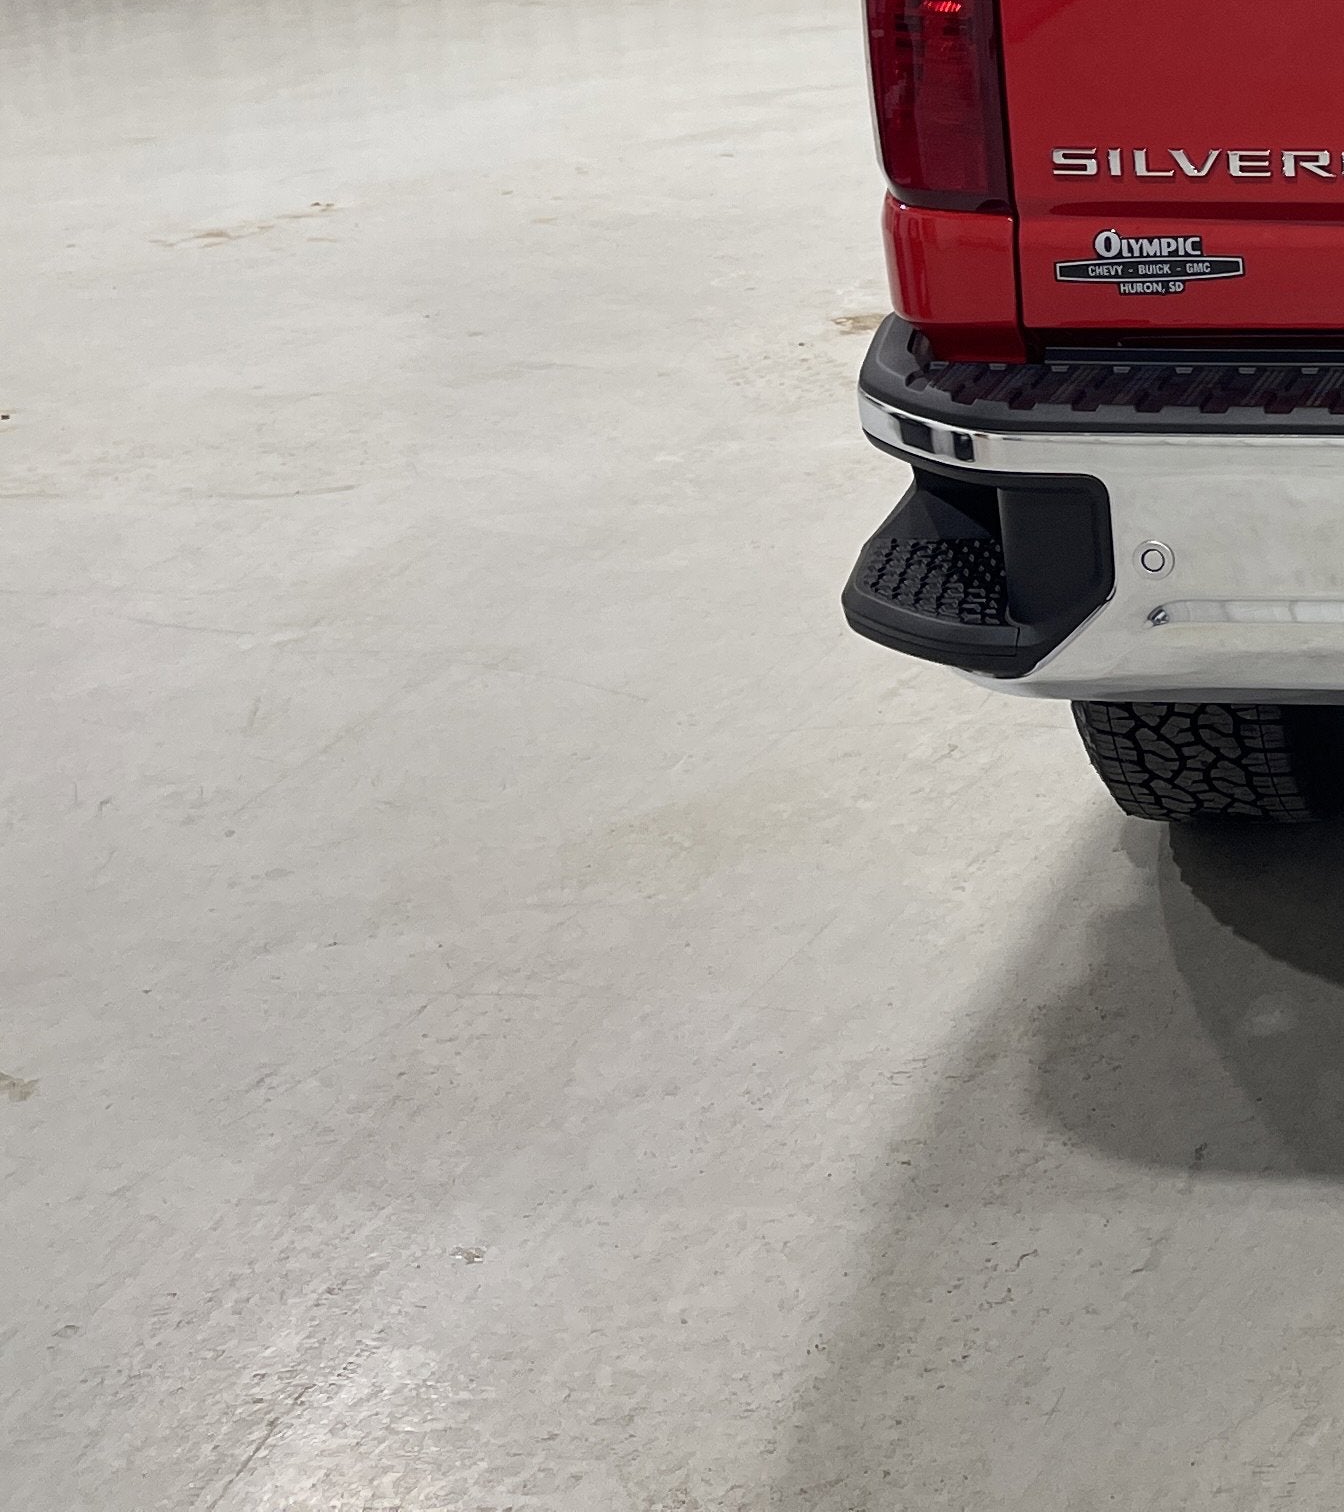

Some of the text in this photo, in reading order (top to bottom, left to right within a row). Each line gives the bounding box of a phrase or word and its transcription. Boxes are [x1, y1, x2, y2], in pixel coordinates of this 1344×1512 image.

[1095, 229, 1201, 257] OLYMPIC
[1088, 265, 1123, 276] CHEVY
[1138, 264, 1171, 275] BUICK
[1186, 262, 1211, 273] GMC
[1120, 282, 1184, 294] HURON, SD
